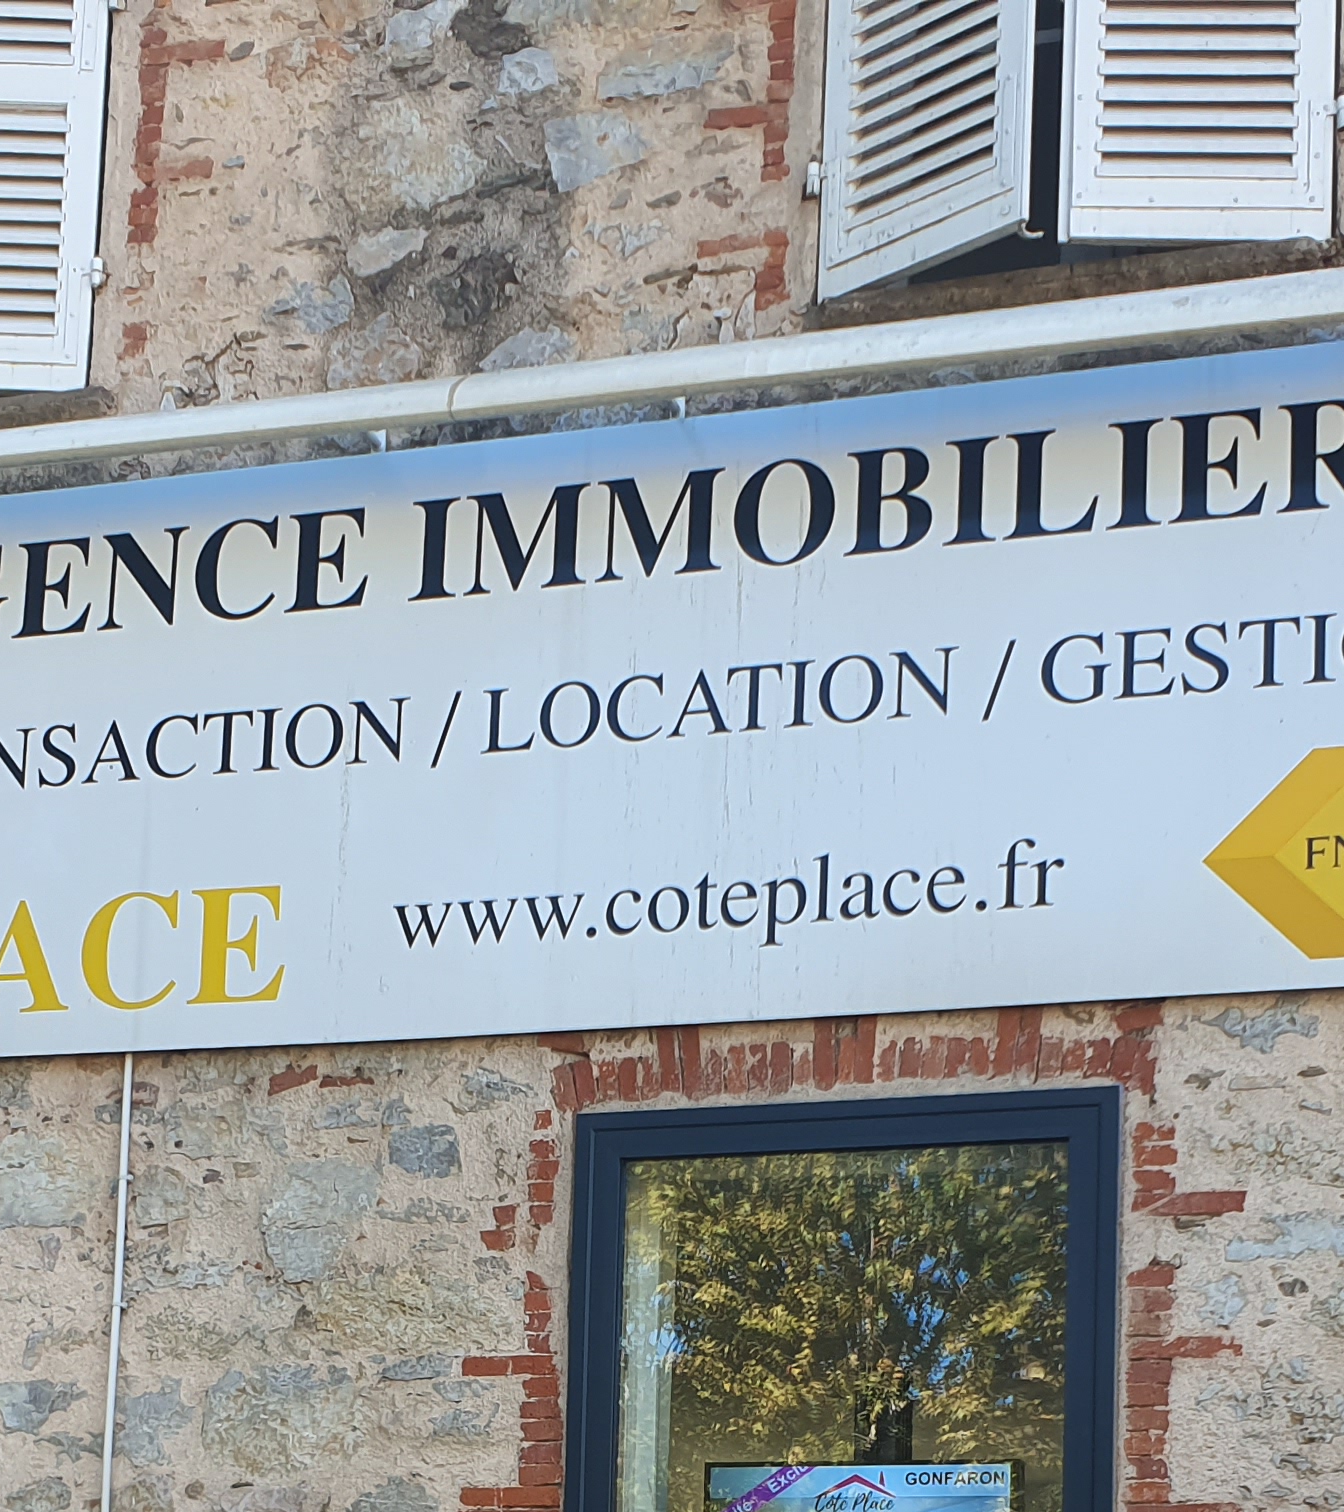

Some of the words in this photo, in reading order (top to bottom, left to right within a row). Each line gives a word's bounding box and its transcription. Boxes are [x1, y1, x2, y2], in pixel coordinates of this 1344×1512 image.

[430, 690, 462, 769] /
[481, 645, 960, 754] LOCATION
[981, 638, 1017, 722] /
[393, 837, 1066, 949] www.coteplace.fr
[814, 1491, 848, 1512] Côté
[905, 1471, 1005, 1487] GONFARON
